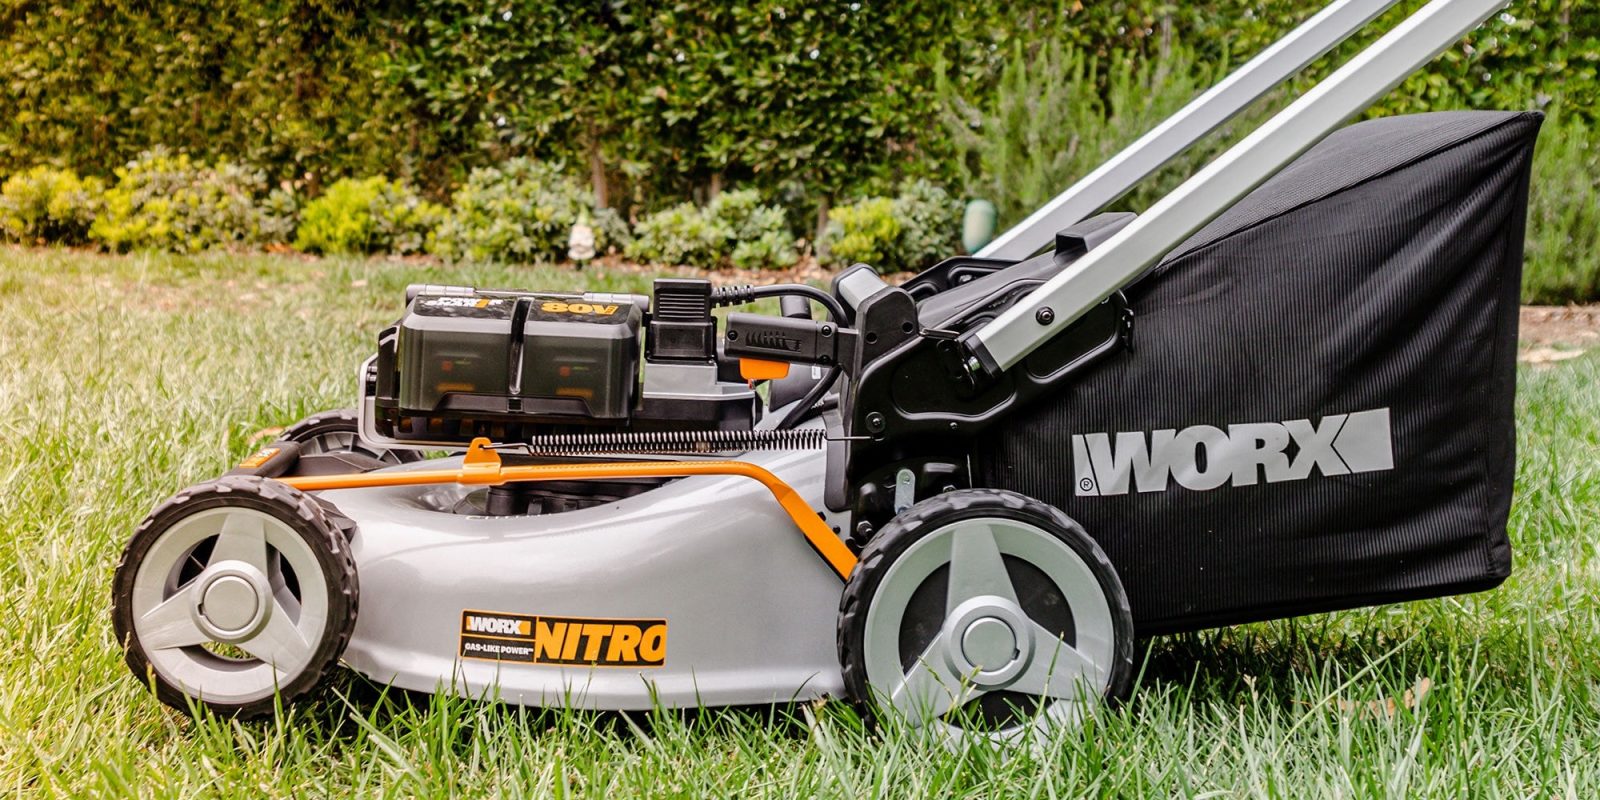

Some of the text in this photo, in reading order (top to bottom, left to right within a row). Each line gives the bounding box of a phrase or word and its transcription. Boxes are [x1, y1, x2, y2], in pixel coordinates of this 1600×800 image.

[1084, 413, 1350, 496] WORX
[469, 615, 521, 635] WORX
[464, 642, 500, 653] GAS-LIKE
[536, 621, 666, 662] NITRO
